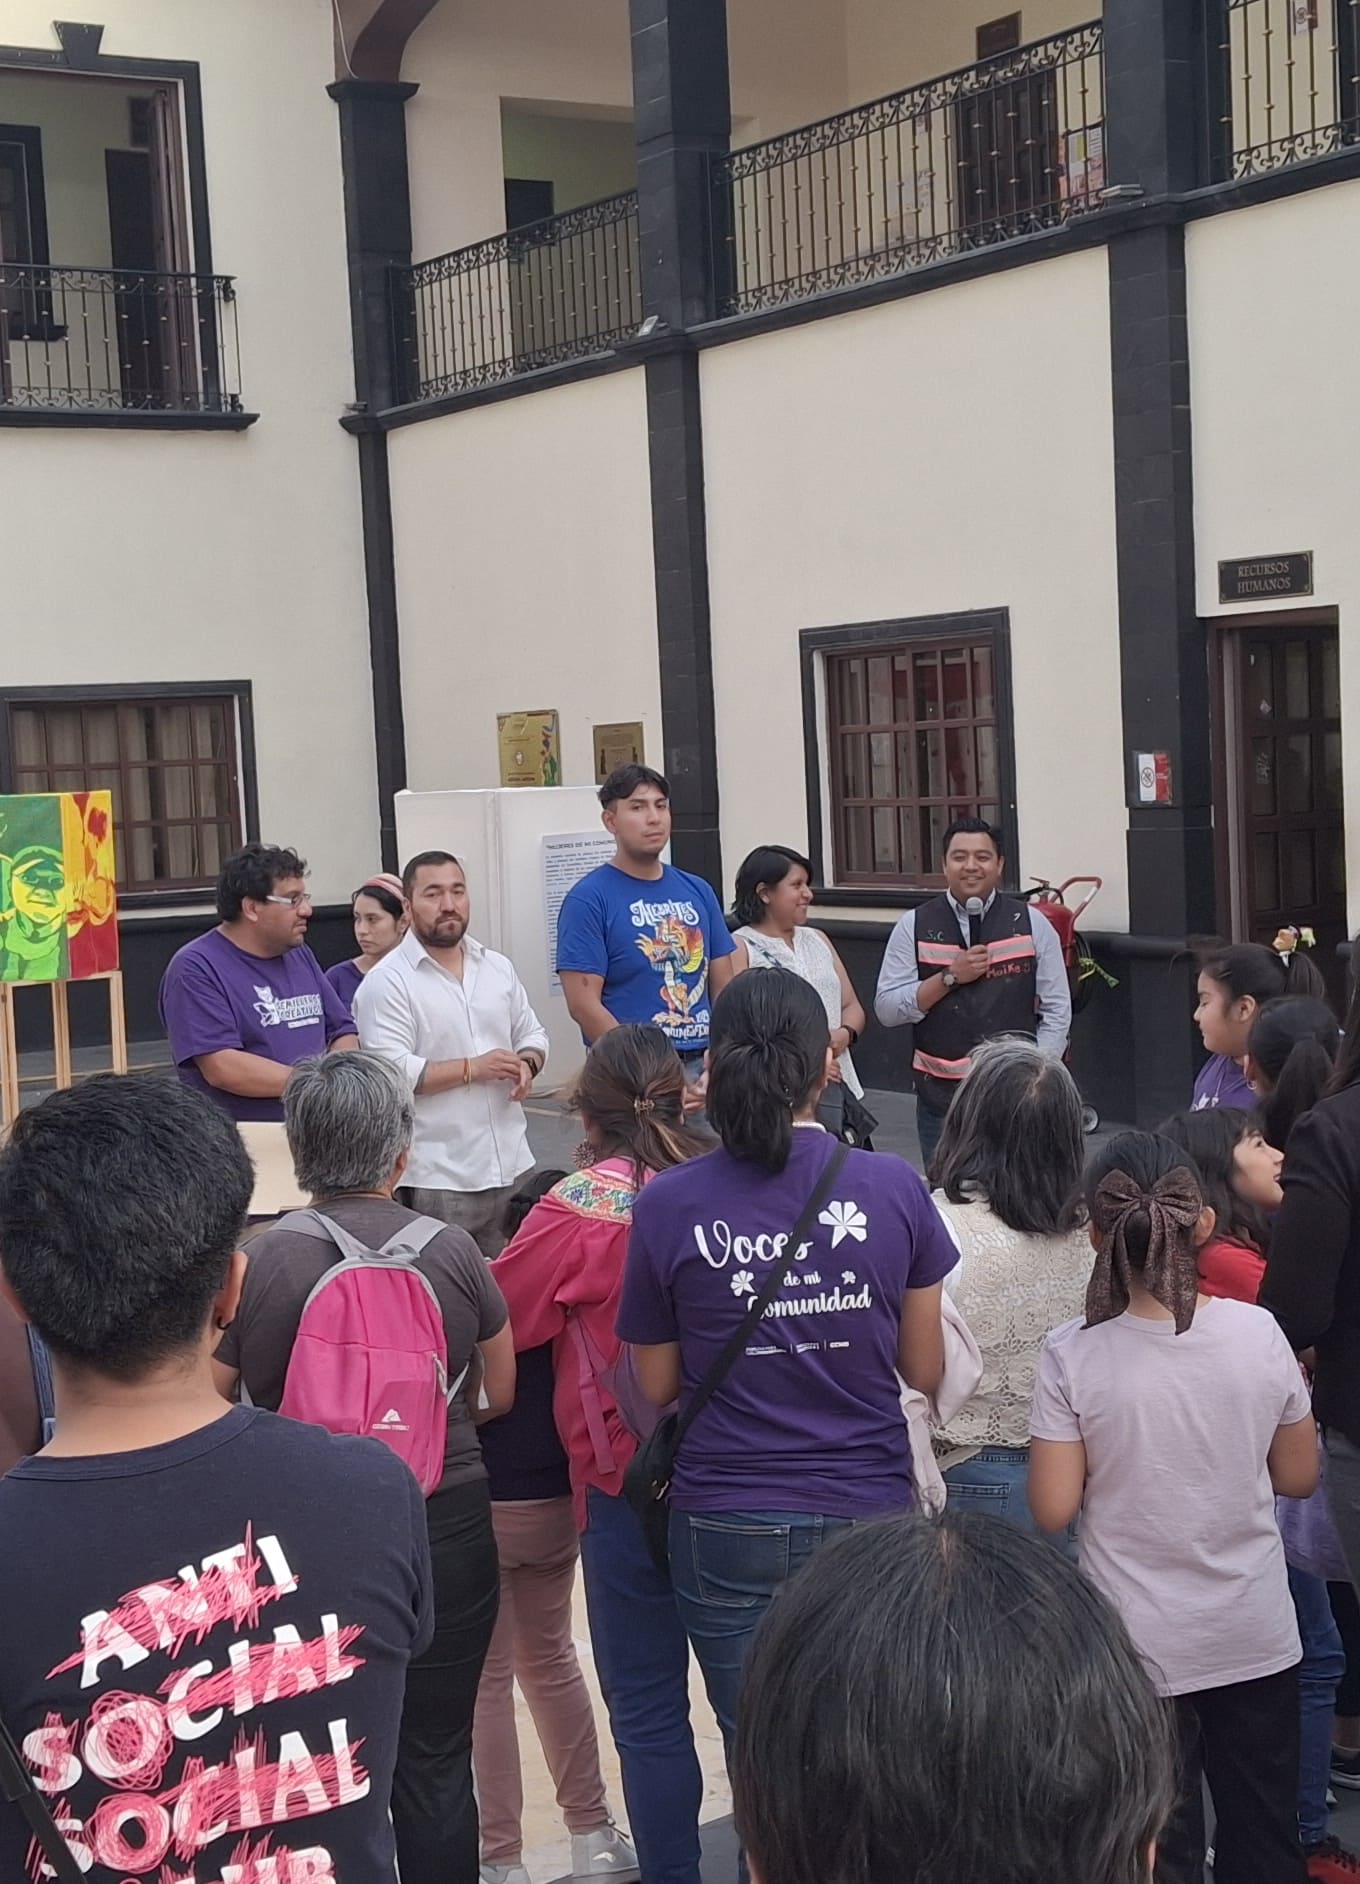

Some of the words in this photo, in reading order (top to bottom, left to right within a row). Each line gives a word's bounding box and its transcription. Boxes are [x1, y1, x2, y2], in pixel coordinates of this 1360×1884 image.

[1237, 561, 1290, 577] RECURSOS
[1237, 577, 1291, 594] HUMANOS
[693, 1219, 814, 1269] Voces
[783, 1270, 801, 1287] de
[803, 1271, 822, 1286] mi
[80, 1534, 298, 1690] ANTI
[21, 1612, 356, 1792] SOCIAL
[38, 1718, 371, 1878] SOCIAL
